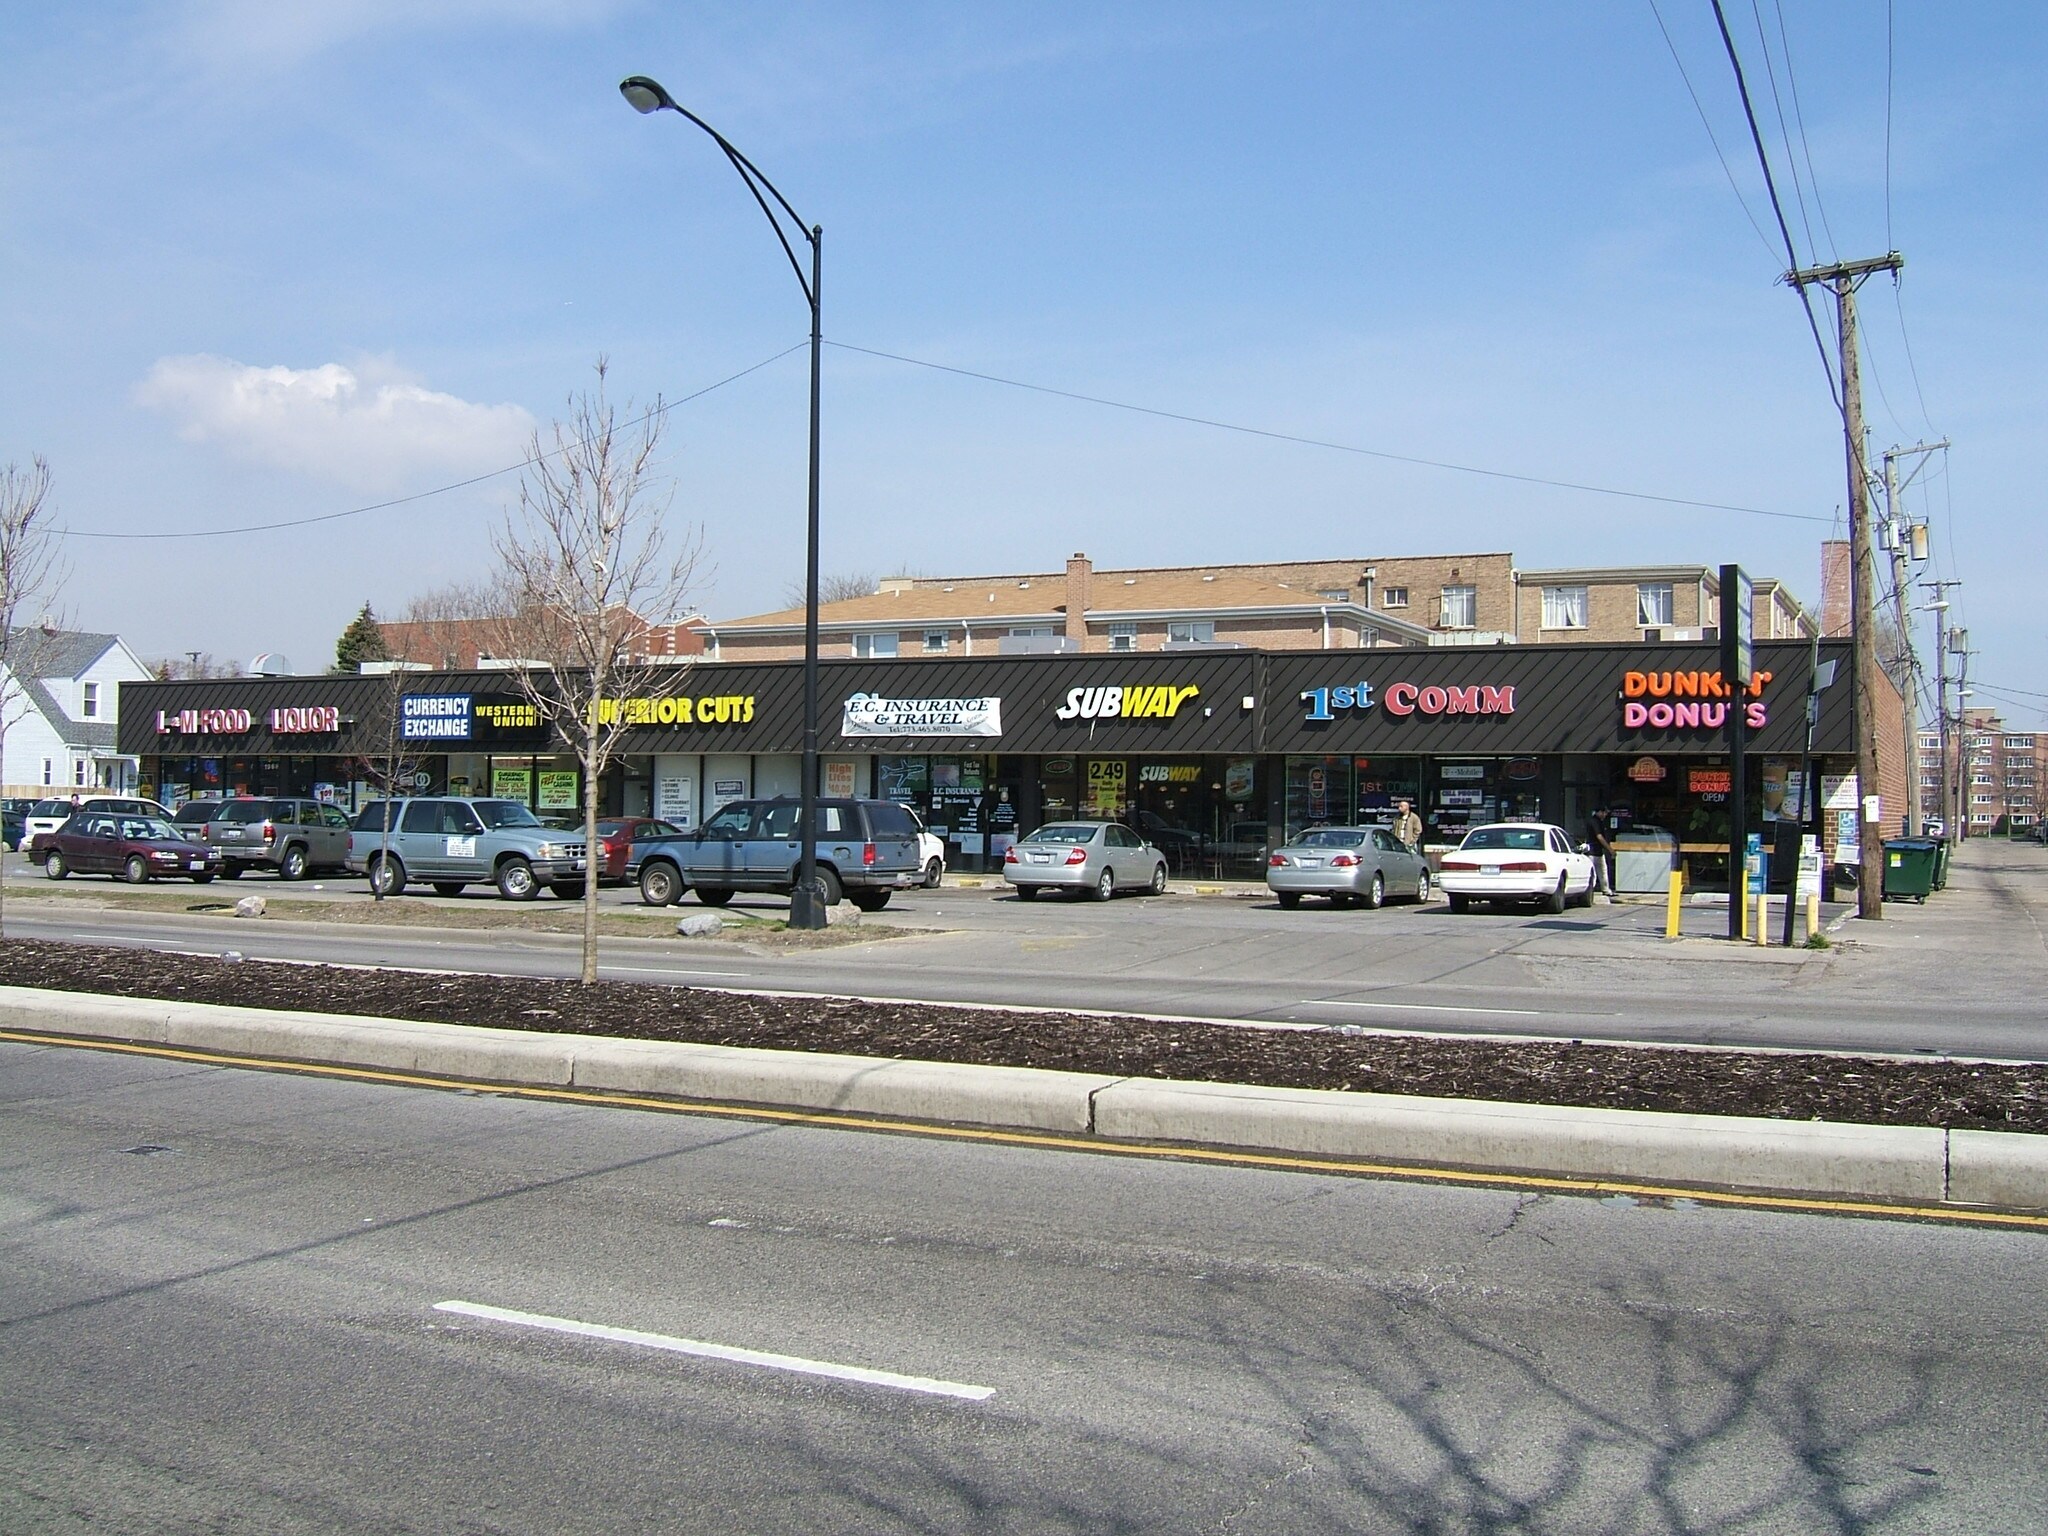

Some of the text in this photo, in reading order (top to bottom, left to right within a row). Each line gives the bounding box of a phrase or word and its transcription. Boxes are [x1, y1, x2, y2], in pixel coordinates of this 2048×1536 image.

[404, 697, 470, 716] CURRENCY
[849, 700, 990, 712] E.C. INSURANCE
[1056, 684, 1199, 721] SUBWAY
[1301, 681, 1375, 720] 1st
[475, 705, 534, 717] WESTERN
[697, 696, 755, 723] CUTS
[1625, 702, 1766, 728] DONUS
[201, 709, 251, 734] FOOD
[271, 706, 339, 734] LIQUOR
[493, 716, 534, 727] UNION
[874, 713, 963, 725] & TRAVEL
[404, 719, 468, 736] EXCHANGE
[829, 763, 852, 774] High
[1139, 766, 1200, 782] SUBWAY
[828, 773, 852, 782] Lites
[889, 787, 912, 795] TRAVEL
[945, 787, 981, 795] INSURANCE
[1360, 781, 1383, 794] 1st
[1702, 792, 1725, 802] OPEN
